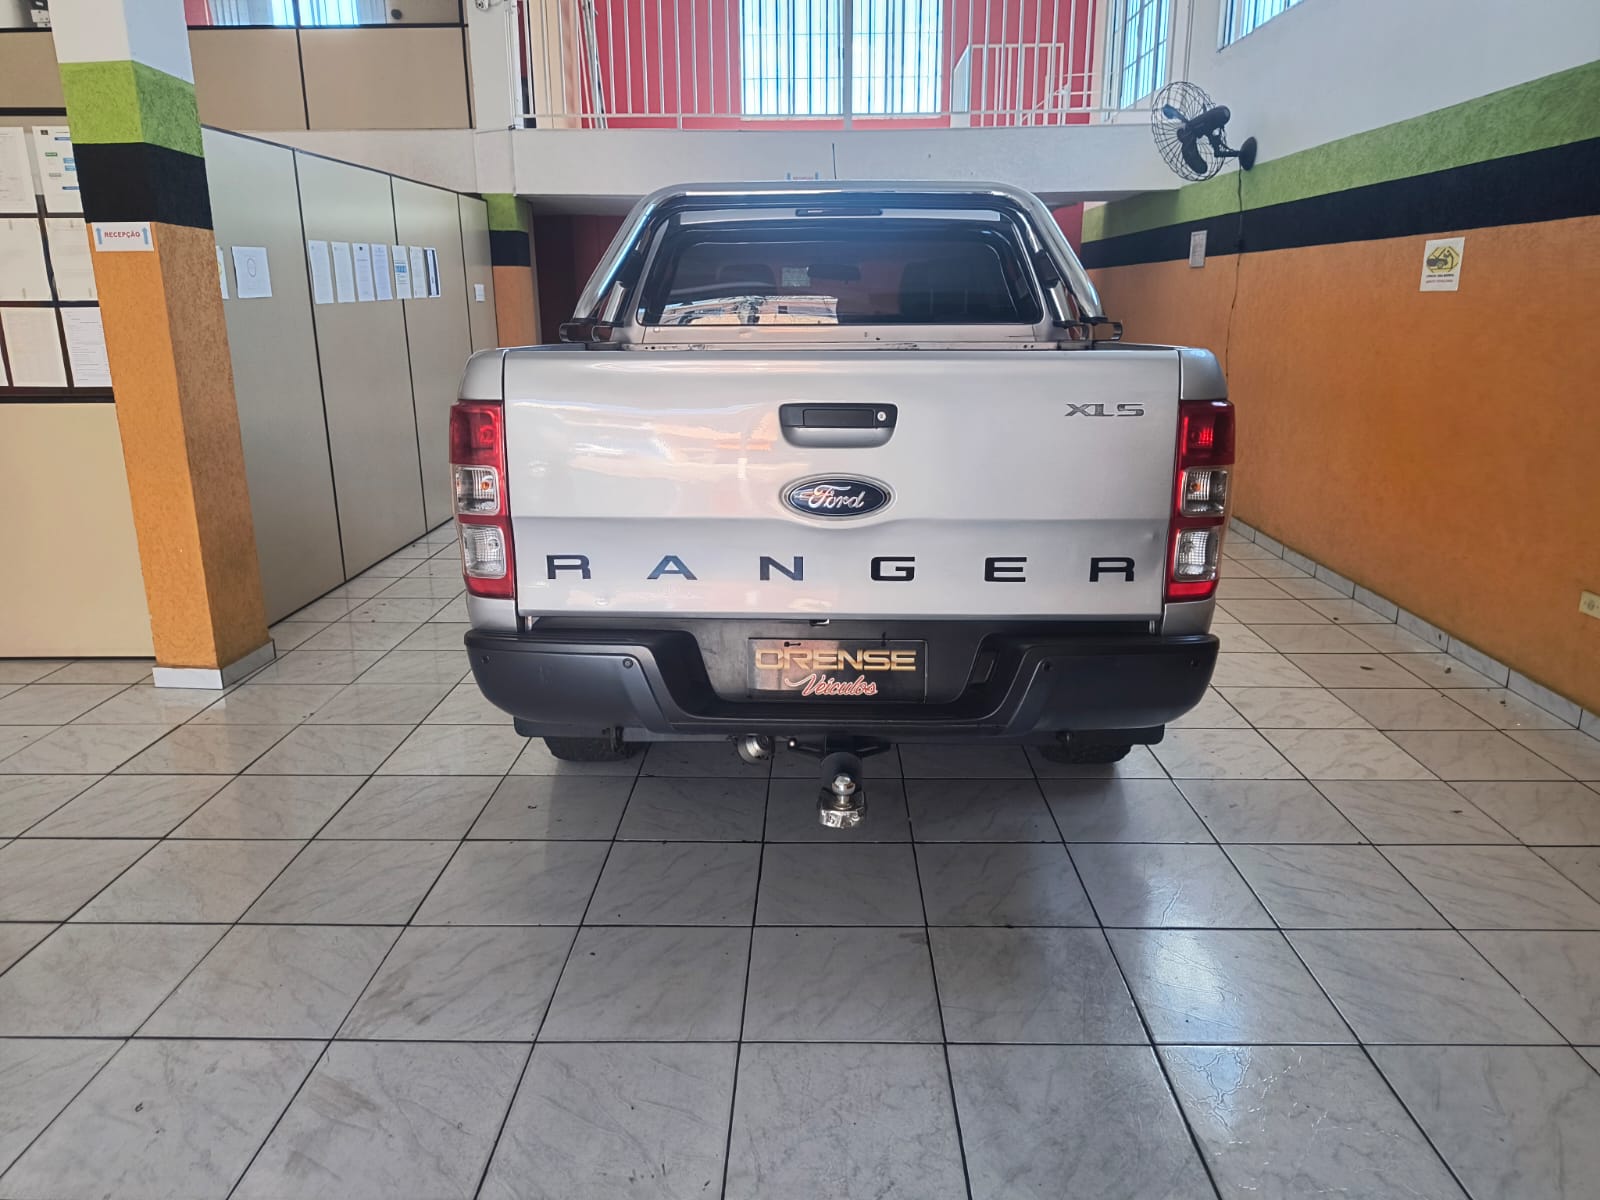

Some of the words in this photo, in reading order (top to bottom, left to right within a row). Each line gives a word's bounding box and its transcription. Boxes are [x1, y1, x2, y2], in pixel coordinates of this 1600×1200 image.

[104, 230, 141, 239] RECEPÇÃO
[1064, 403, 1145, 417] XLS
[808, 484, 866, 509] Ford
[546, 554, 1136, 583] RANGER
[755, 649, 917, 671] ORENSE
